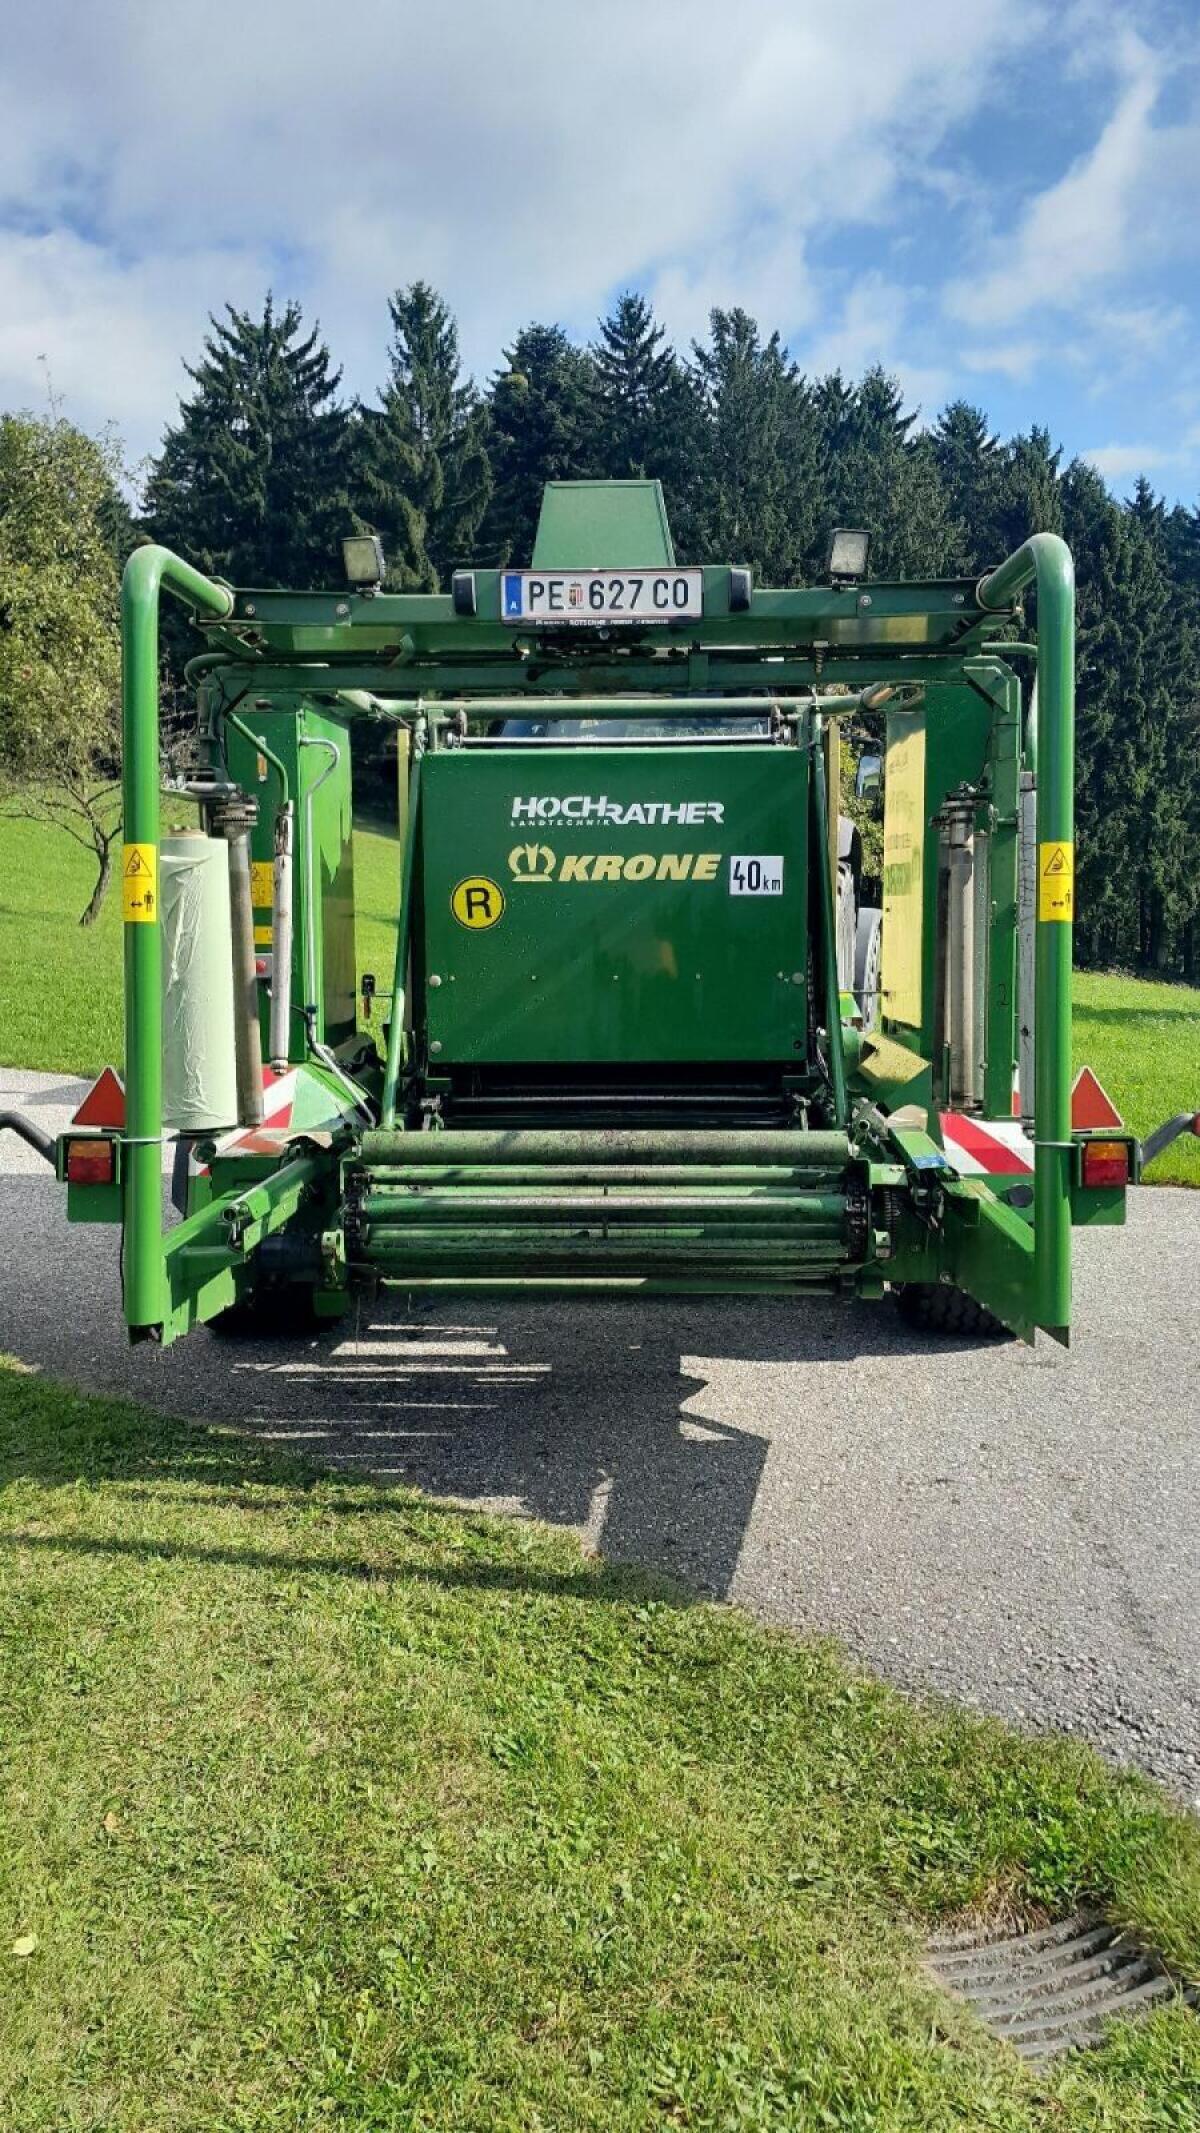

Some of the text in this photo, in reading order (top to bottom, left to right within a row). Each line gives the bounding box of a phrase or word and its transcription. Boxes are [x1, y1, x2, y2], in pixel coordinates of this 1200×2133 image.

[510, 602, 517, 610] A
[529, 579, 688, 611] PE 627 CO
[511, 795, 725, 825] HOCHRATHER
[559, 854, 722, 881] KRONE
[466, 887, 493, 920] R
